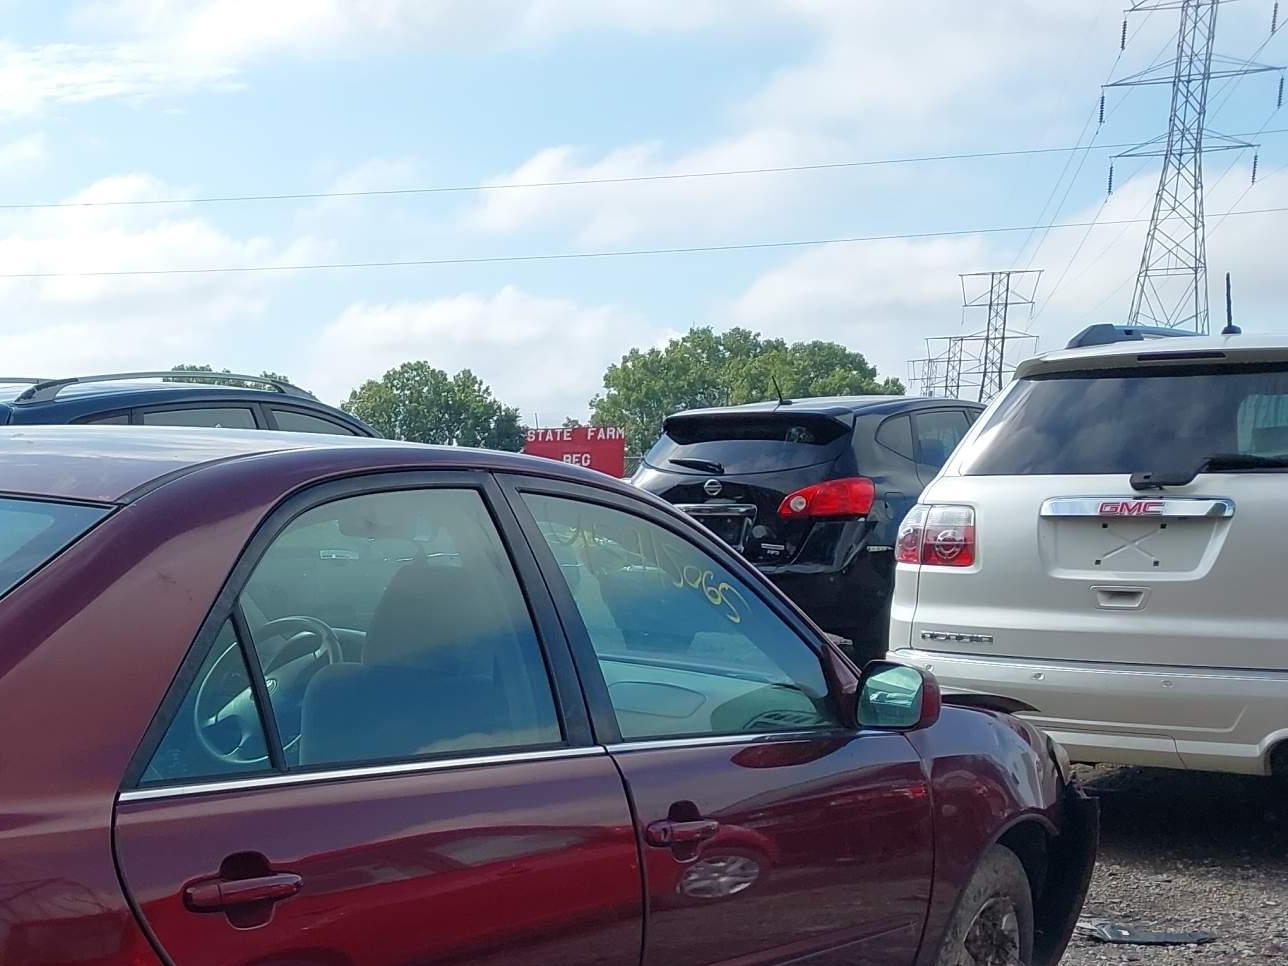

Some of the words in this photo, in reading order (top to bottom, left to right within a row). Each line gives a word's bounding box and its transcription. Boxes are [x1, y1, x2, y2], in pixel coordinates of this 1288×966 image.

[527, 429, 572, 442] STATE
[587, 426, 625, 440] FARM
[1099, 501, 1165, 516] GMC
